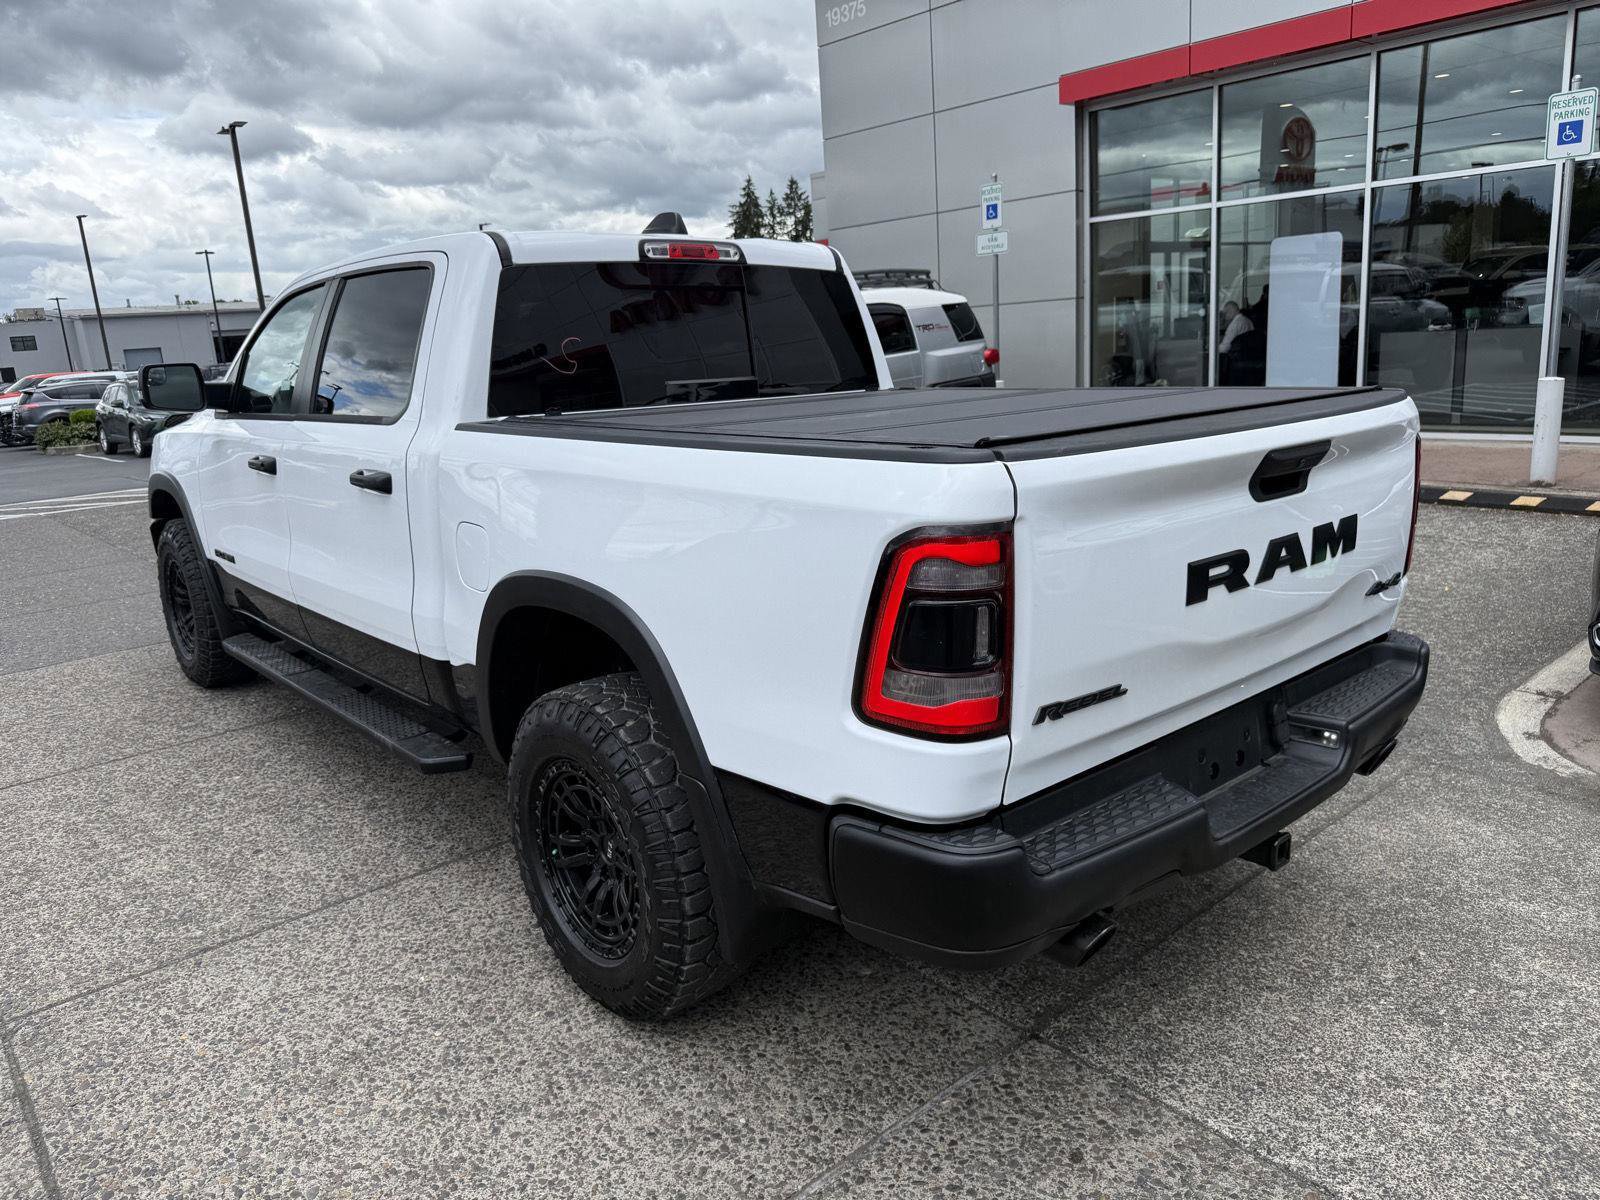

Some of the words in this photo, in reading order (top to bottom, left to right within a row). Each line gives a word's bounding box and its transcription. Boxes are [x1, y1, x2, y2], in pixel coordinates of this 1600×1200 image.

[825, 0, 866, 27] 19375
[1552, 95, 1594, 109] RESERVED
[1554, 107, 1590, 120] PARKING
[1185, 513, 1358, 607] RAM
